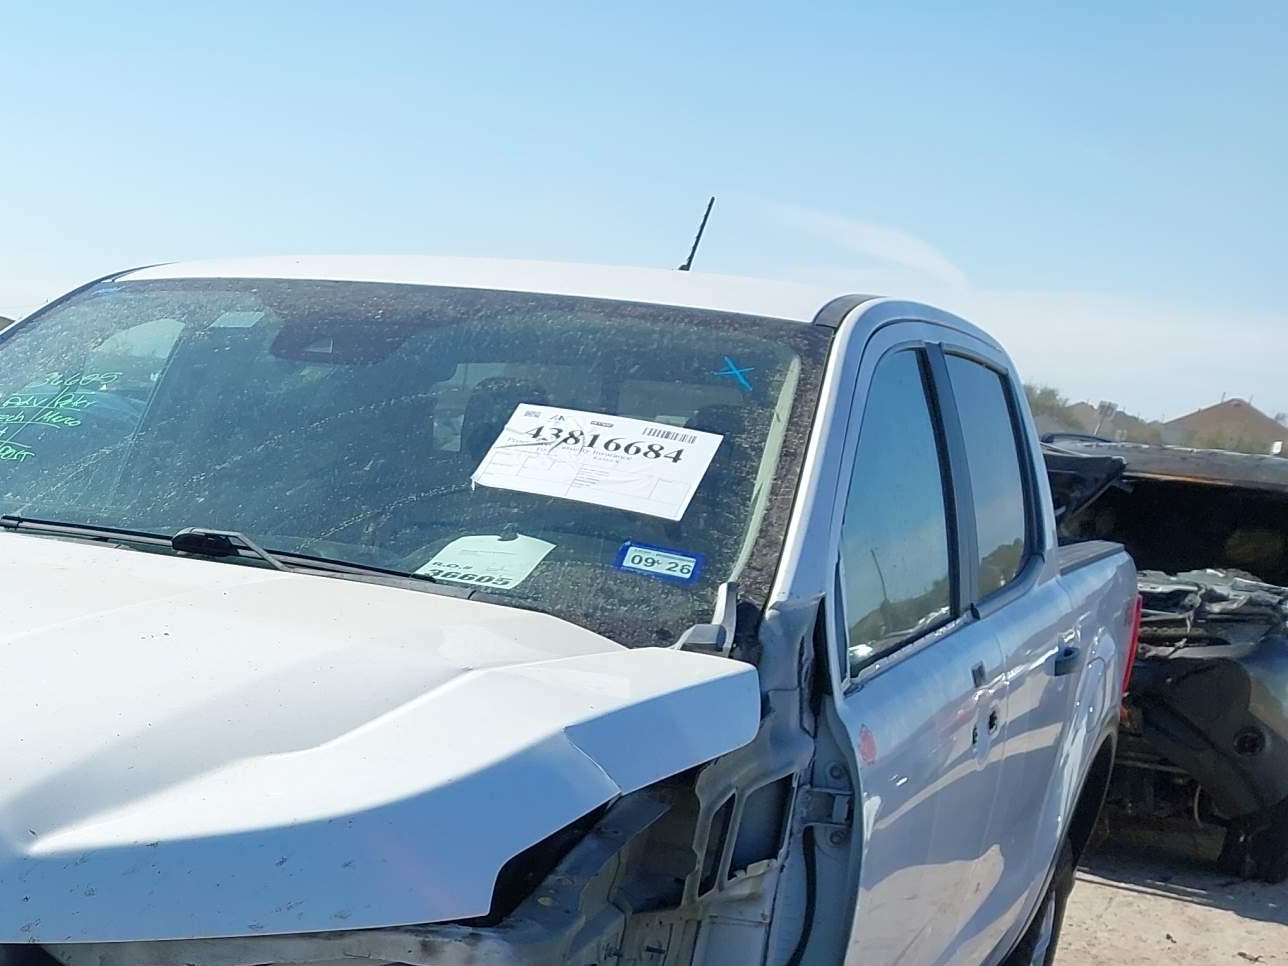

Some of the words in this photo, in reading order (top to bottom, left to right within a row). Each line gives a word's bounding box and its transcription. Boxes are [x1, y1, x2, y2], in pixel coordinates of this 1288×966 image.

[523, 424, 685, 464] 43816684
[630, 553, 657, 568] 09
[665, 561, 692, 575] 26
[423, 568, 514, 587] 36605
